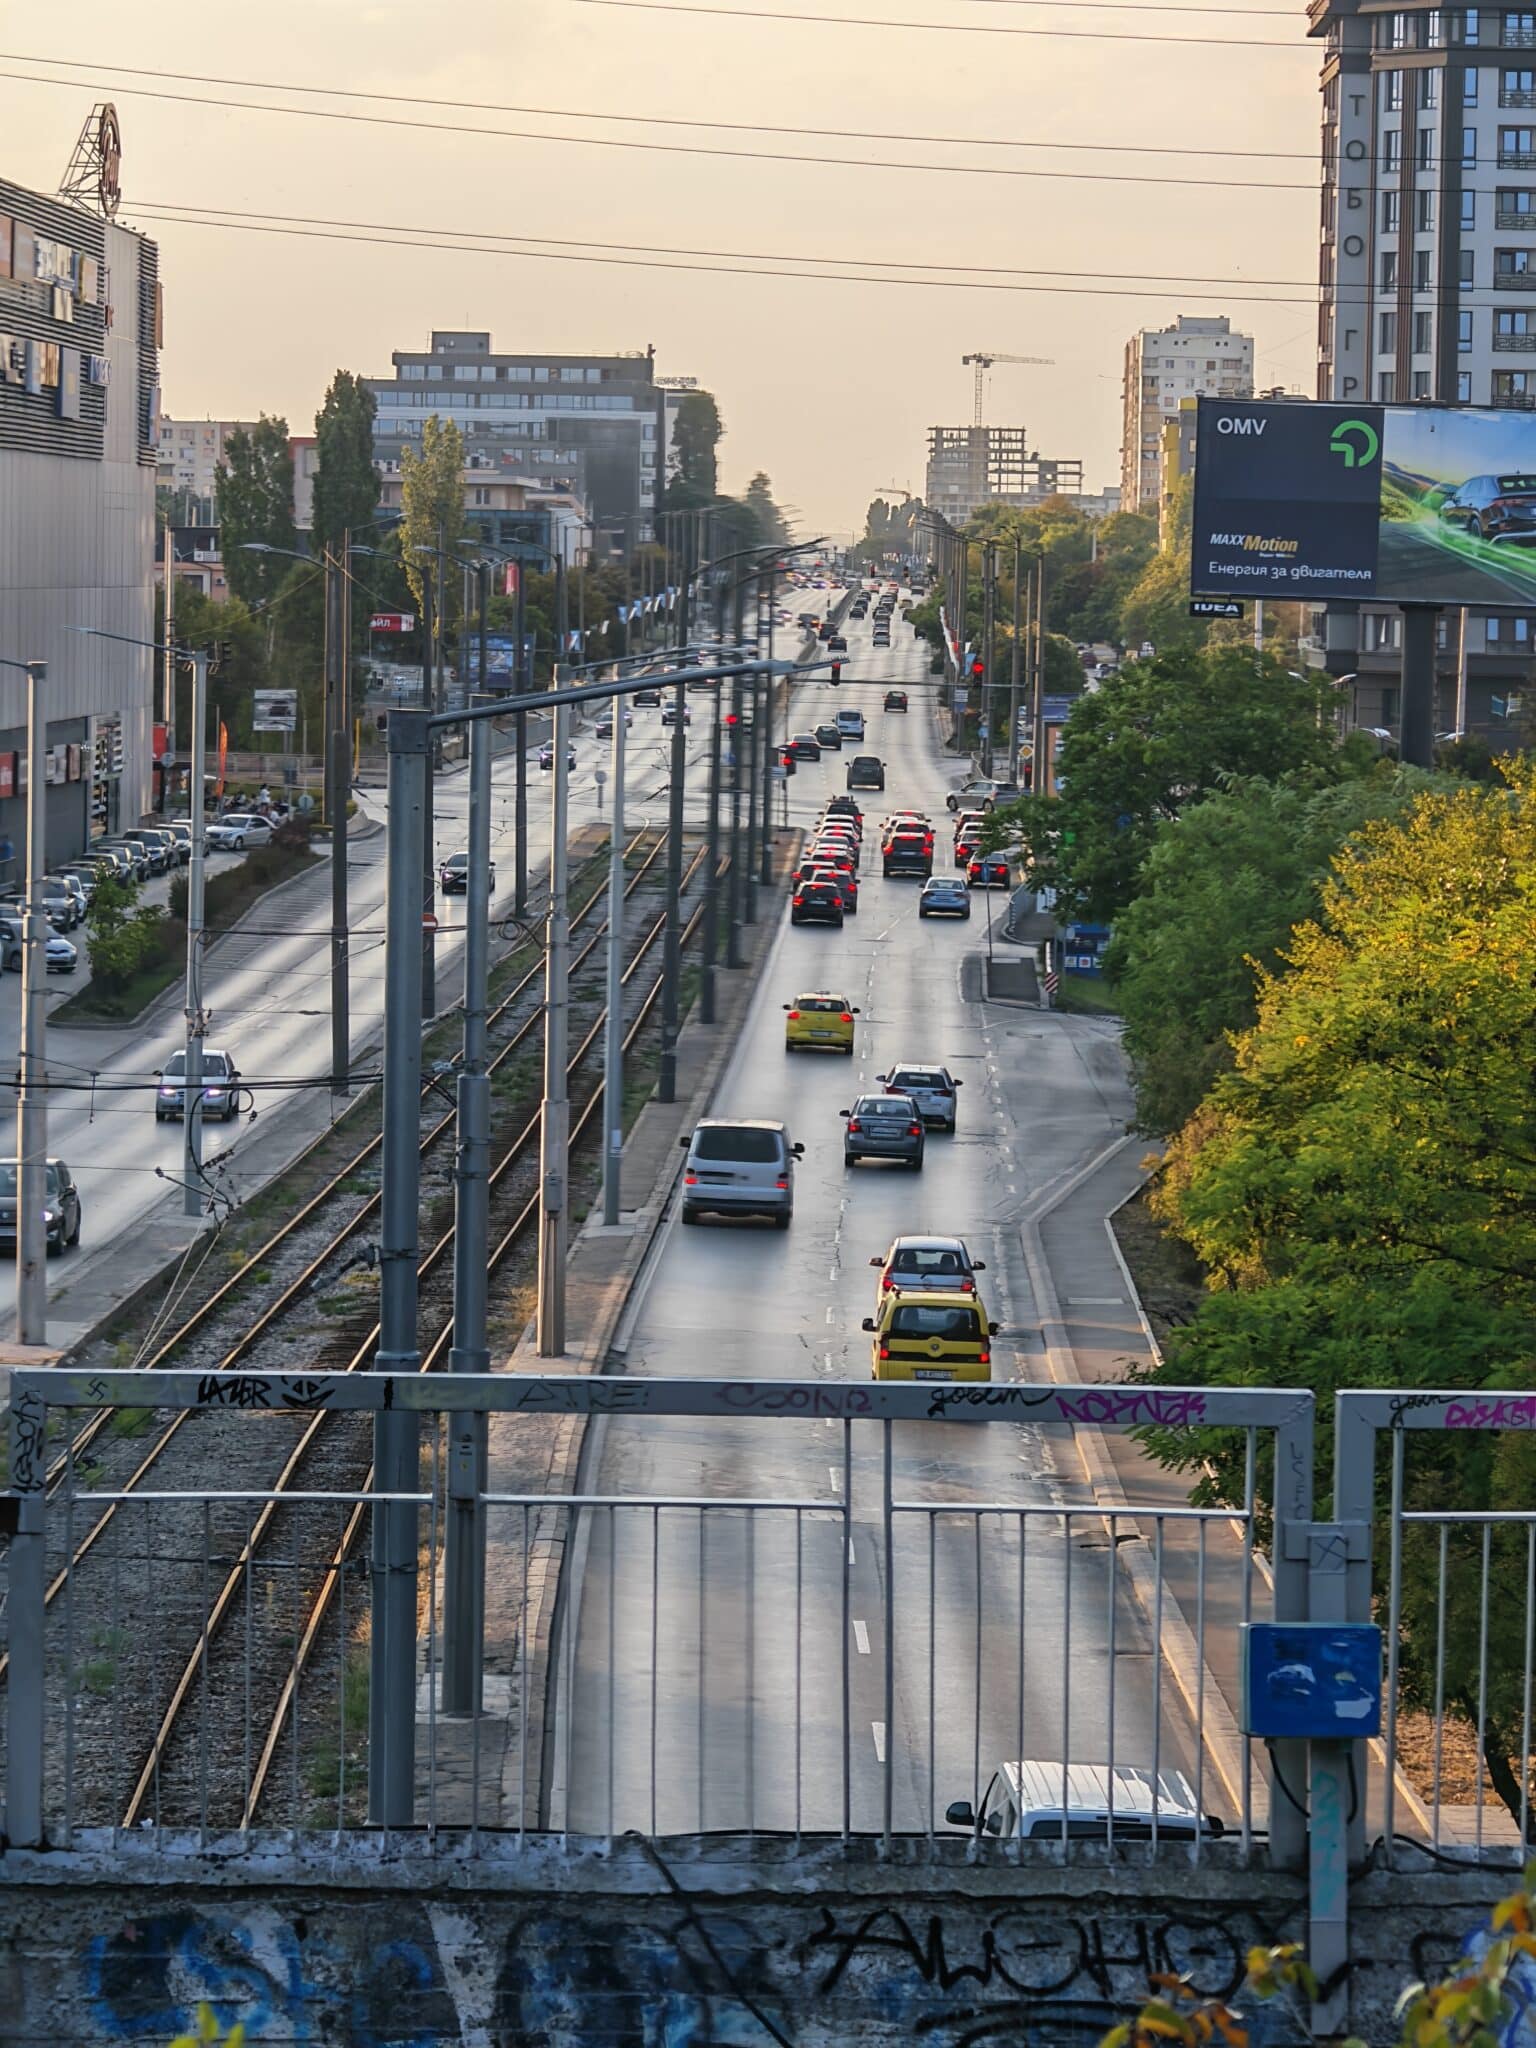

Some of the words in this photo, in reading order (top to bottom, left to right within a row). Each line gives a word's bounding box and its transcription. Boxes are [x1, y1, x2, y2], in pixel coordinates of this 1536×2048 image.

[1216, 417, 1267, 436] OMV
[1208, 561, 1268, 577] Енергия
[1270, 567, 1287, 580] за
[1290, 565, 1372, 580] двигателя
